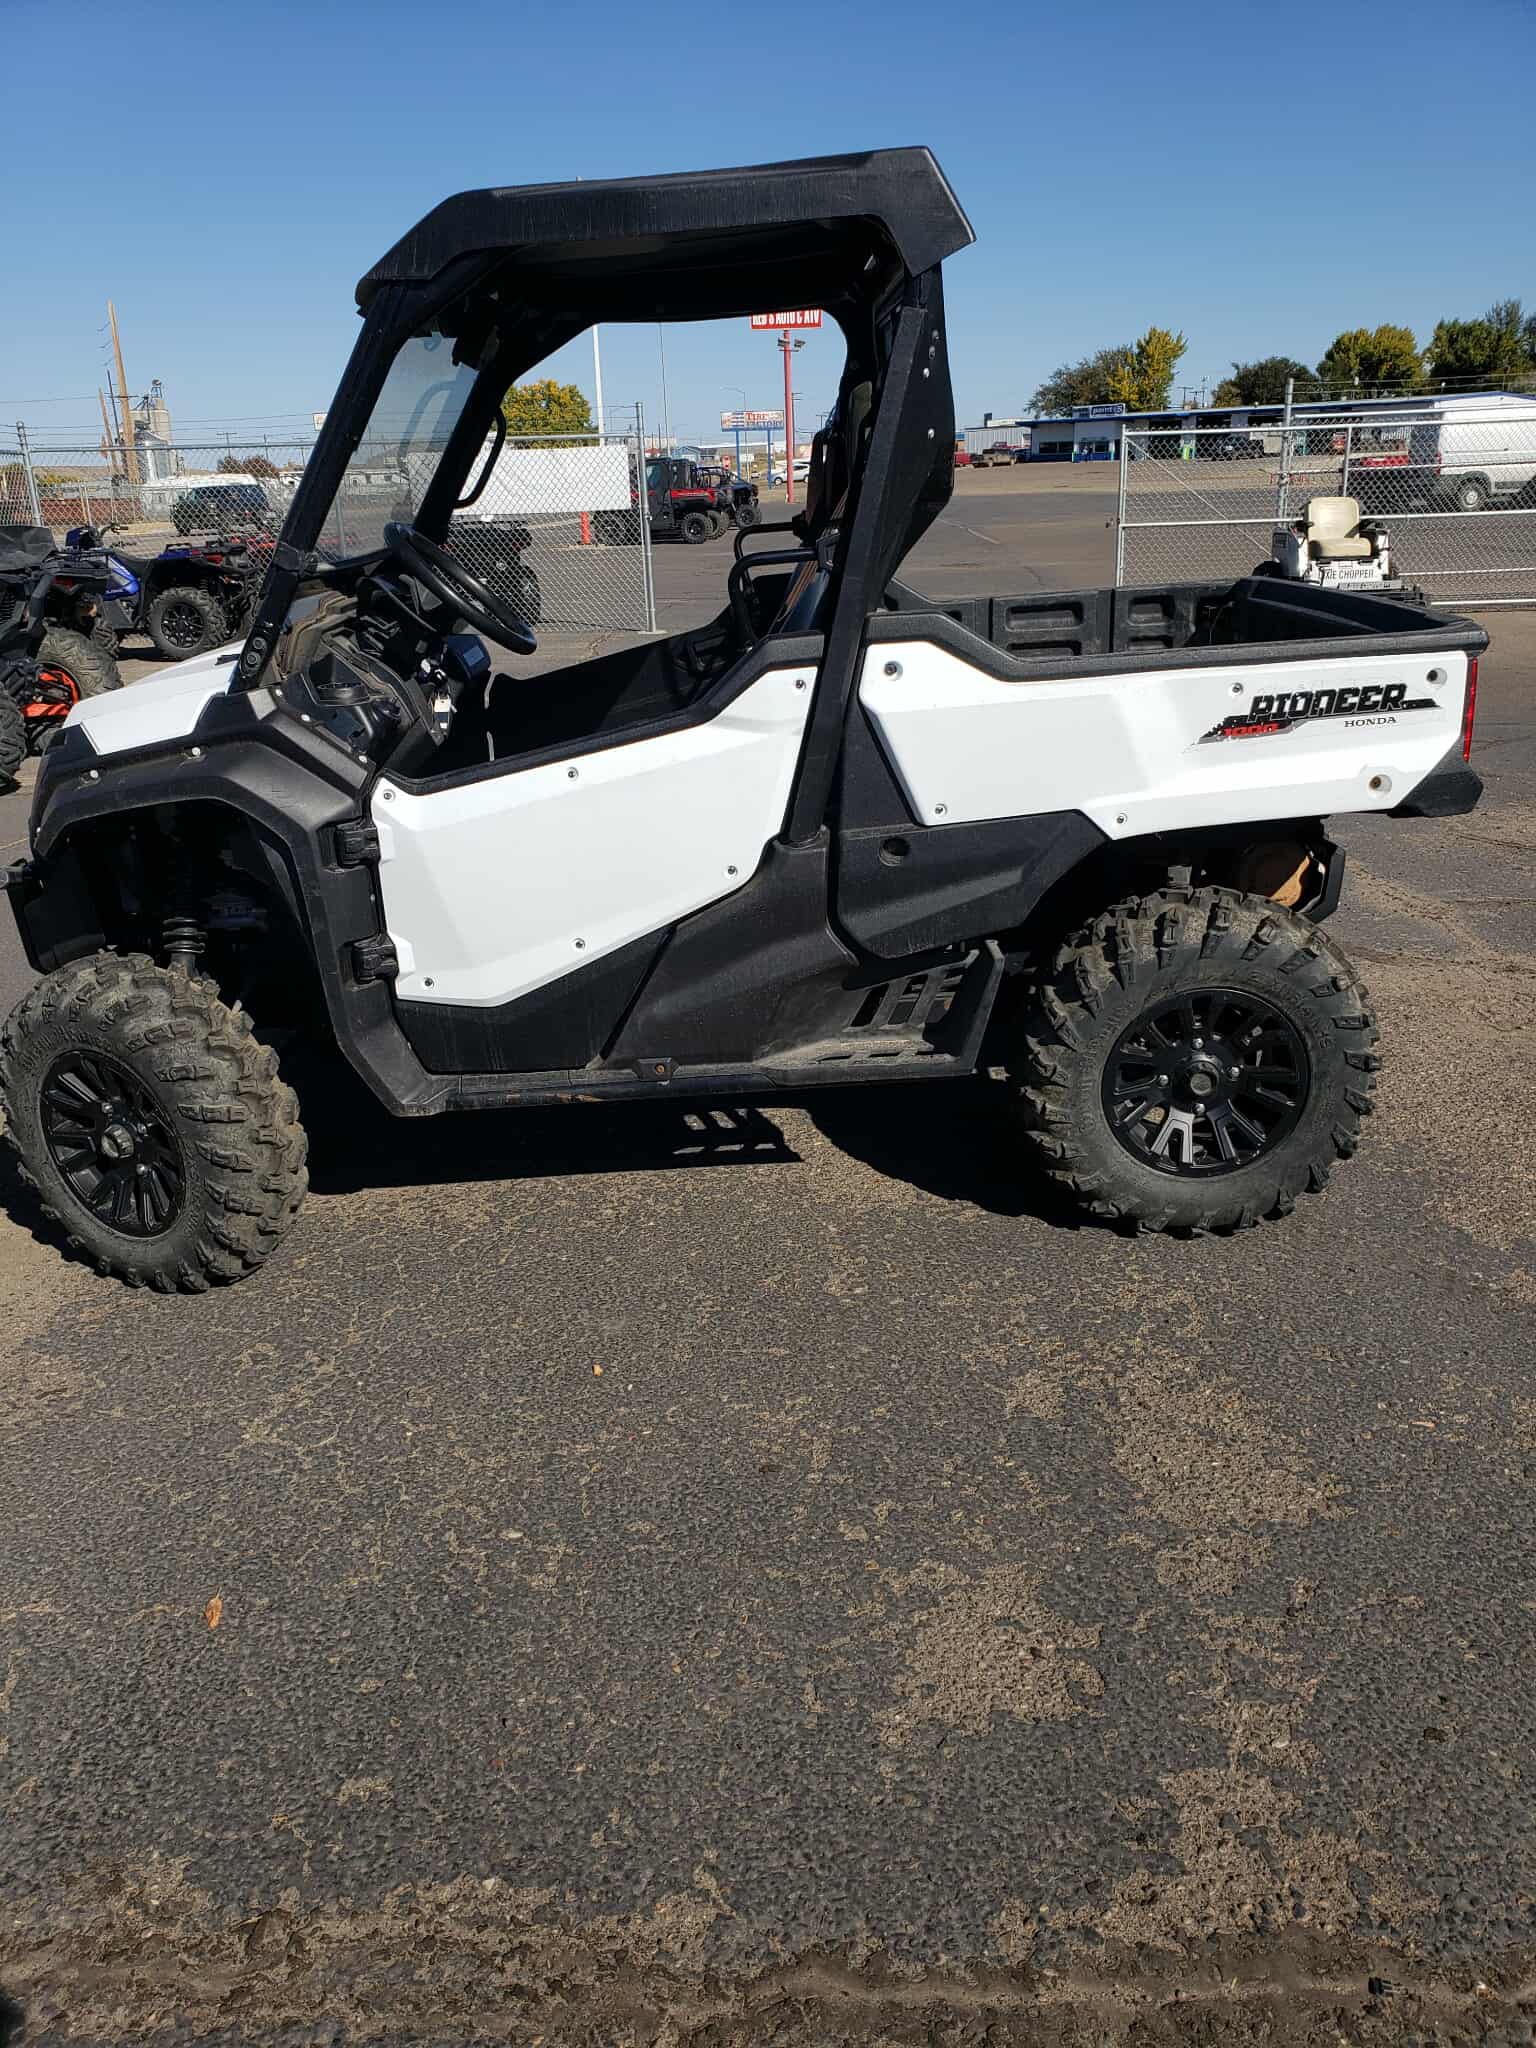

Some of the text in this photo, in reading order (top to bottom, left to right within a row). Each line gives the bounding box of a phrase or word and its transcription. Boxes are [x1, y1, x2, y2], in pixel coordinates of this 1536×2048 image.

[1338, 568, 1374, 580] CHOPPER
[1248, 683, 1408, 722] PIONEER
[1344, 716, 1397, 728] HONDA
[1224, 722, 1280, 737] 1000
